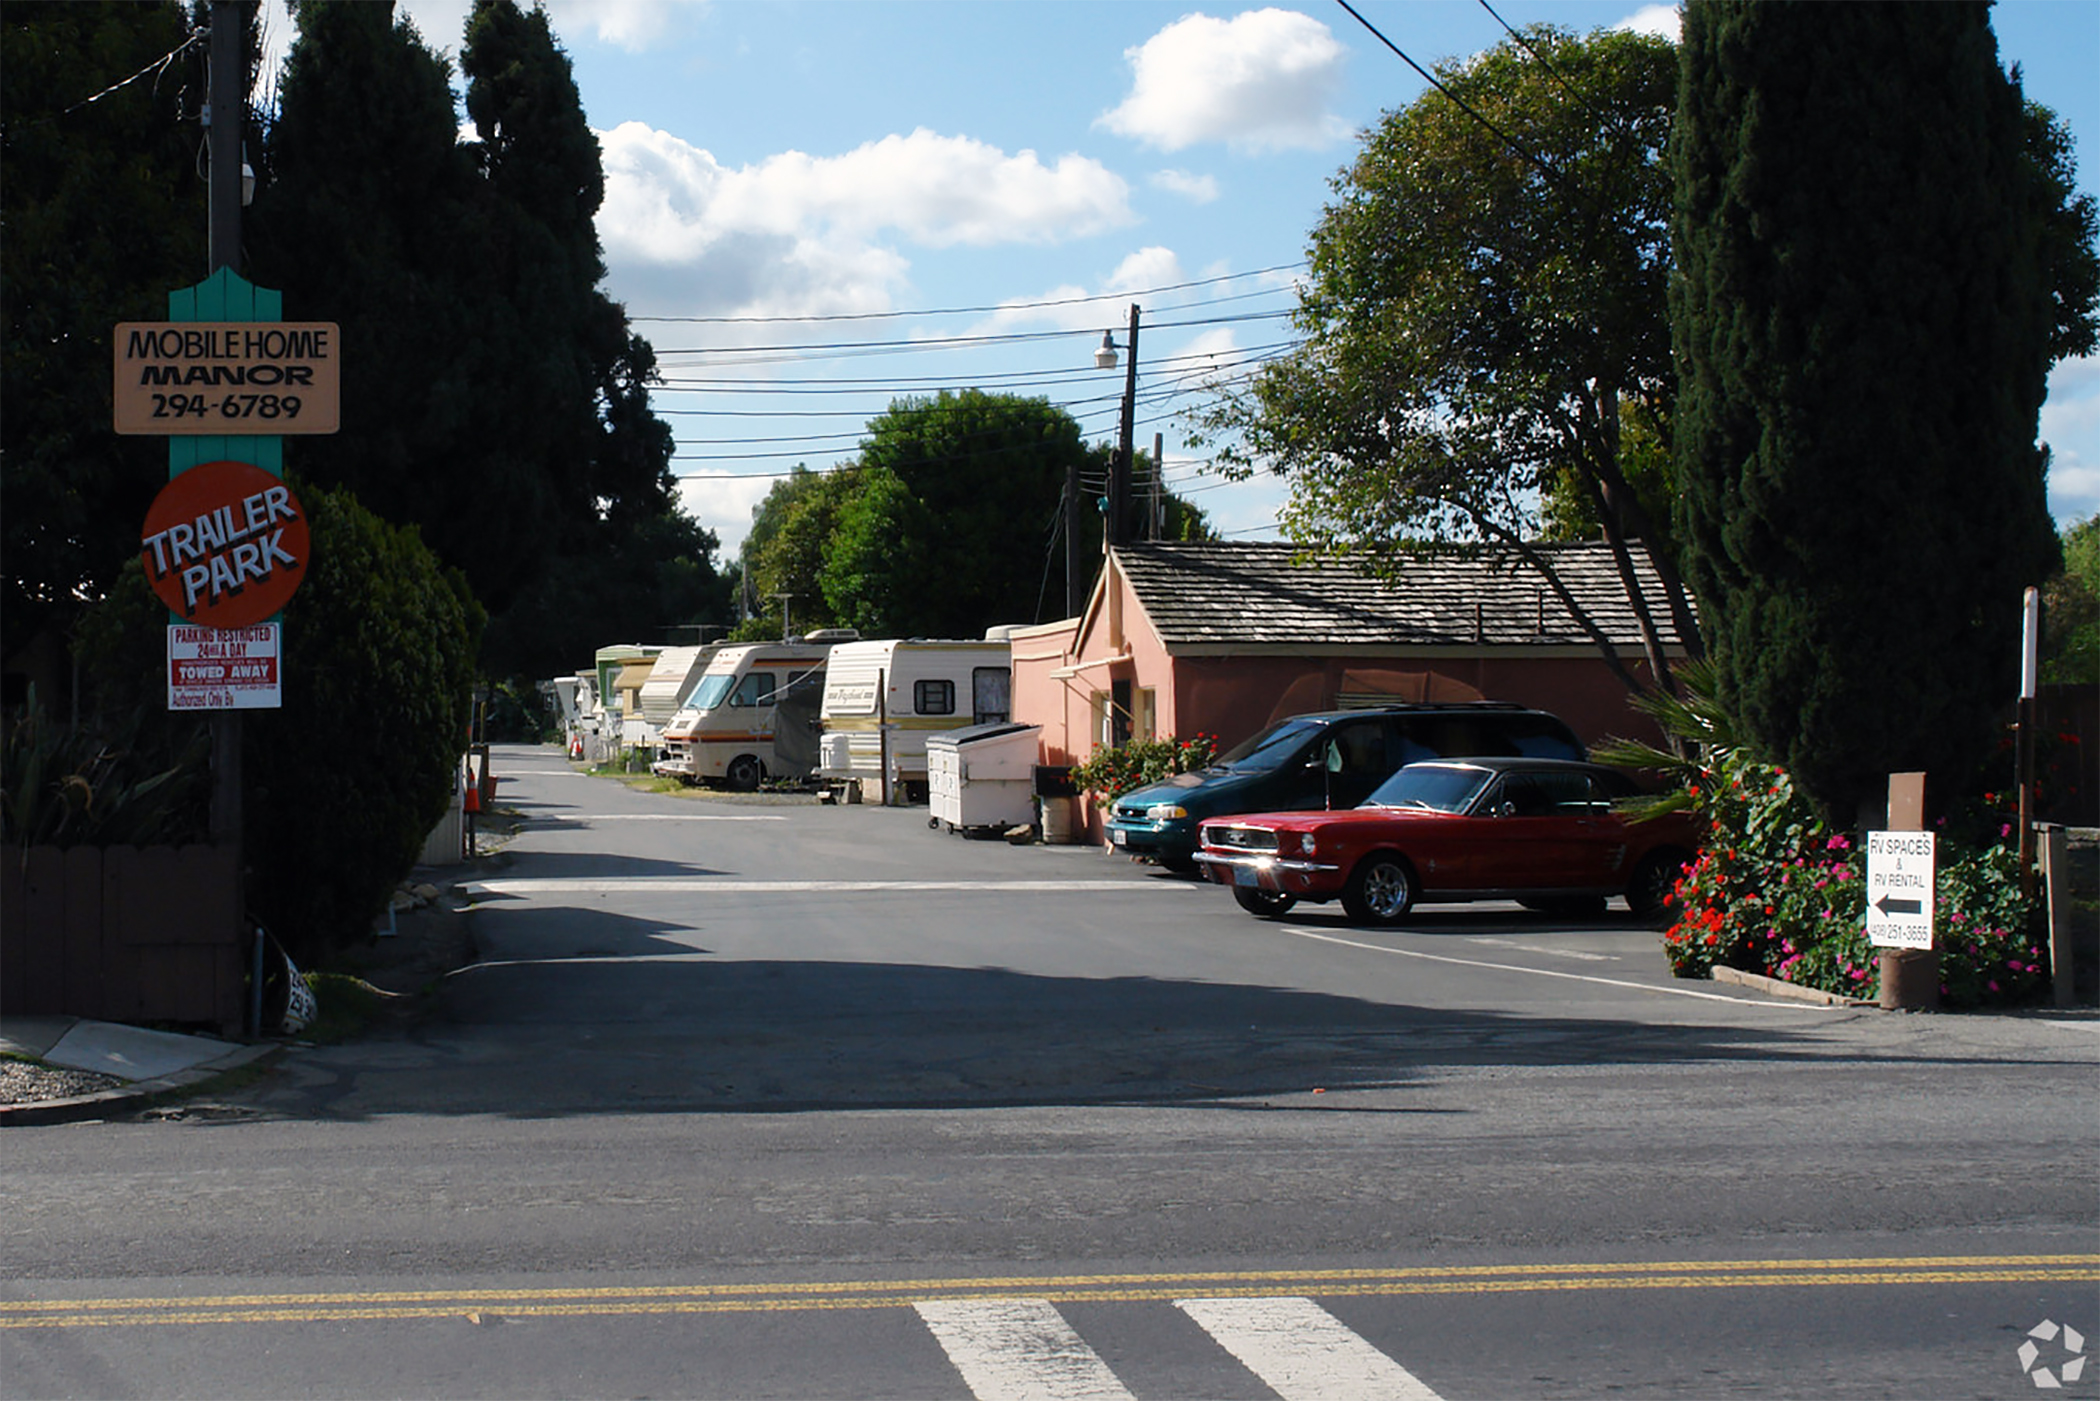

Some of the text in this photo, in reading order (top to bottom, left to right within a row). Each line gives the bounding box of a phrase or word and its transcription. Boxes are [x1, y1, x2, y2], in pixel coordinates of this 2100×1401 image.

[127, 329, 328, 359] MOBILE HOME
[140, 364, 314, 386] MANOR
[151, 393, 302, 418] 294-6789
[143, 485, 298, 578] TRAILER
[183, 528, 298, 611] PARK
[175, 627, 271, 643] PARKING RESTRICTED
[197, 643, 209, 658] 24
[220, 643, 227, 657] A
[230, 643, 247, 657] DAY
[179, 665, 269, 679] TOWED AWAY
[172, 692, 206, 707] Authorized
[208, 691, 222, 707] Only
[1870, 839, 1931, 856] RV SPACES
[1896, 857, 1902, 870] &
[1874, 873, 1925, 888] RV RENTAL
[1887, 924, 1928, 942] 251-3655
